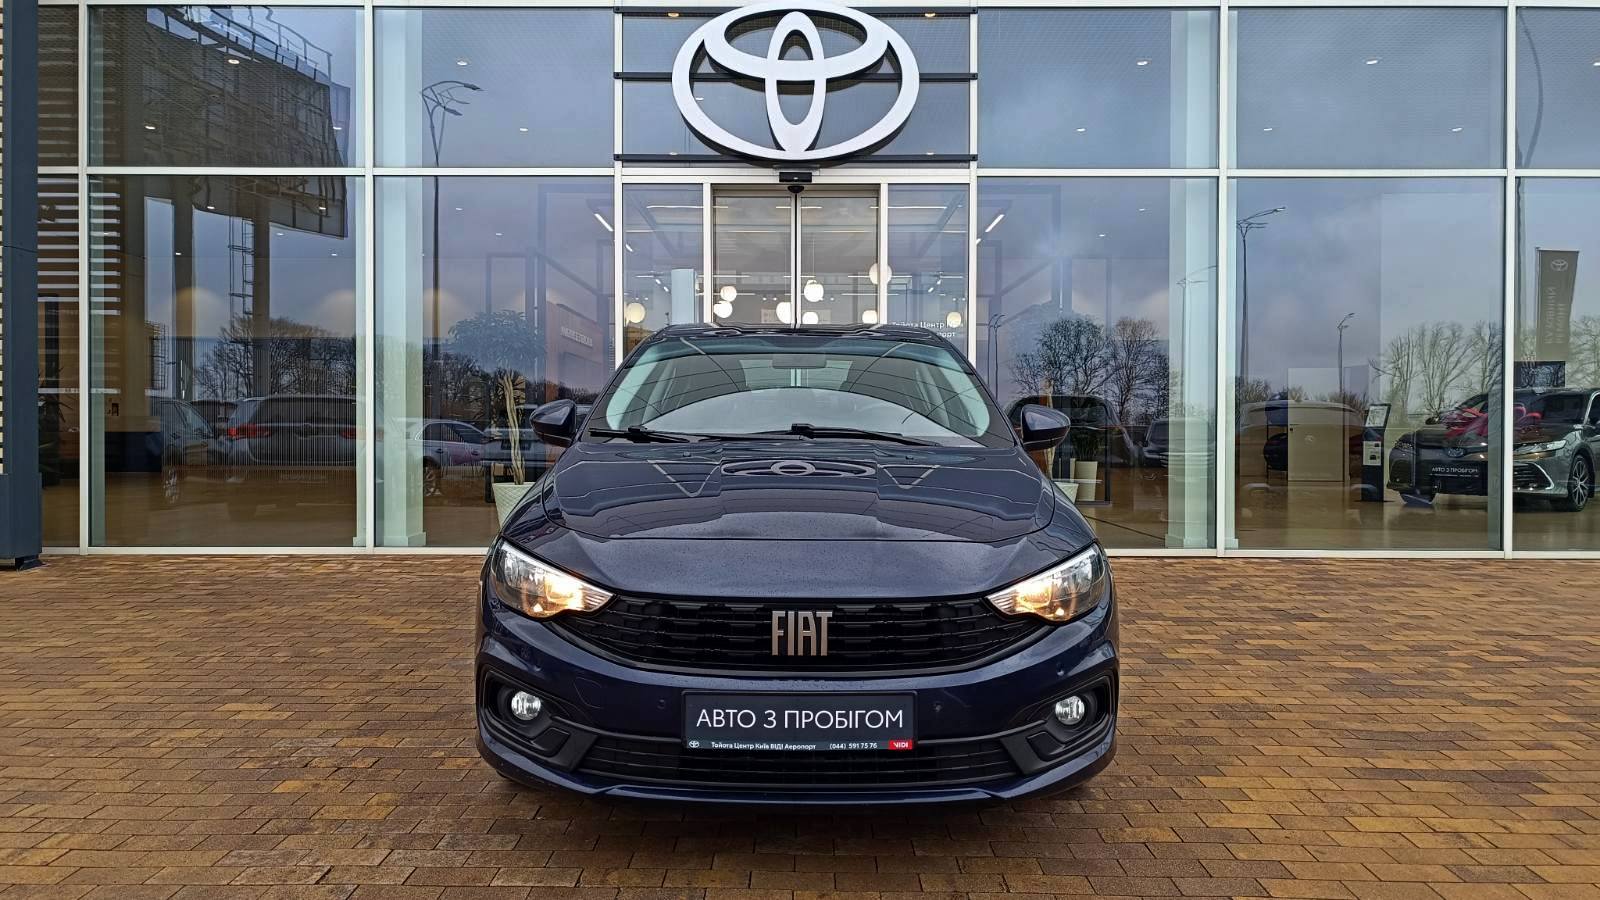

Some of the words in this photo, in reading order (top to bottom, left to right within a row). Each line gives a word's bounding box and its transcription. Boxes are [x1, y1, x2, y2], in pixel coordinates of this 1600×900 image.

[771, 610, 833, 656] FIAT
[696, 709, 756, 728] АВТО
[763, 710, 777, 728] З
[784, 709, 903, 729] ПРОБІГОМ
[711, 741, 733, 749] Тойота
[734, 742, 754, 750] Центр
[829, 742, 847, 750] (044)
